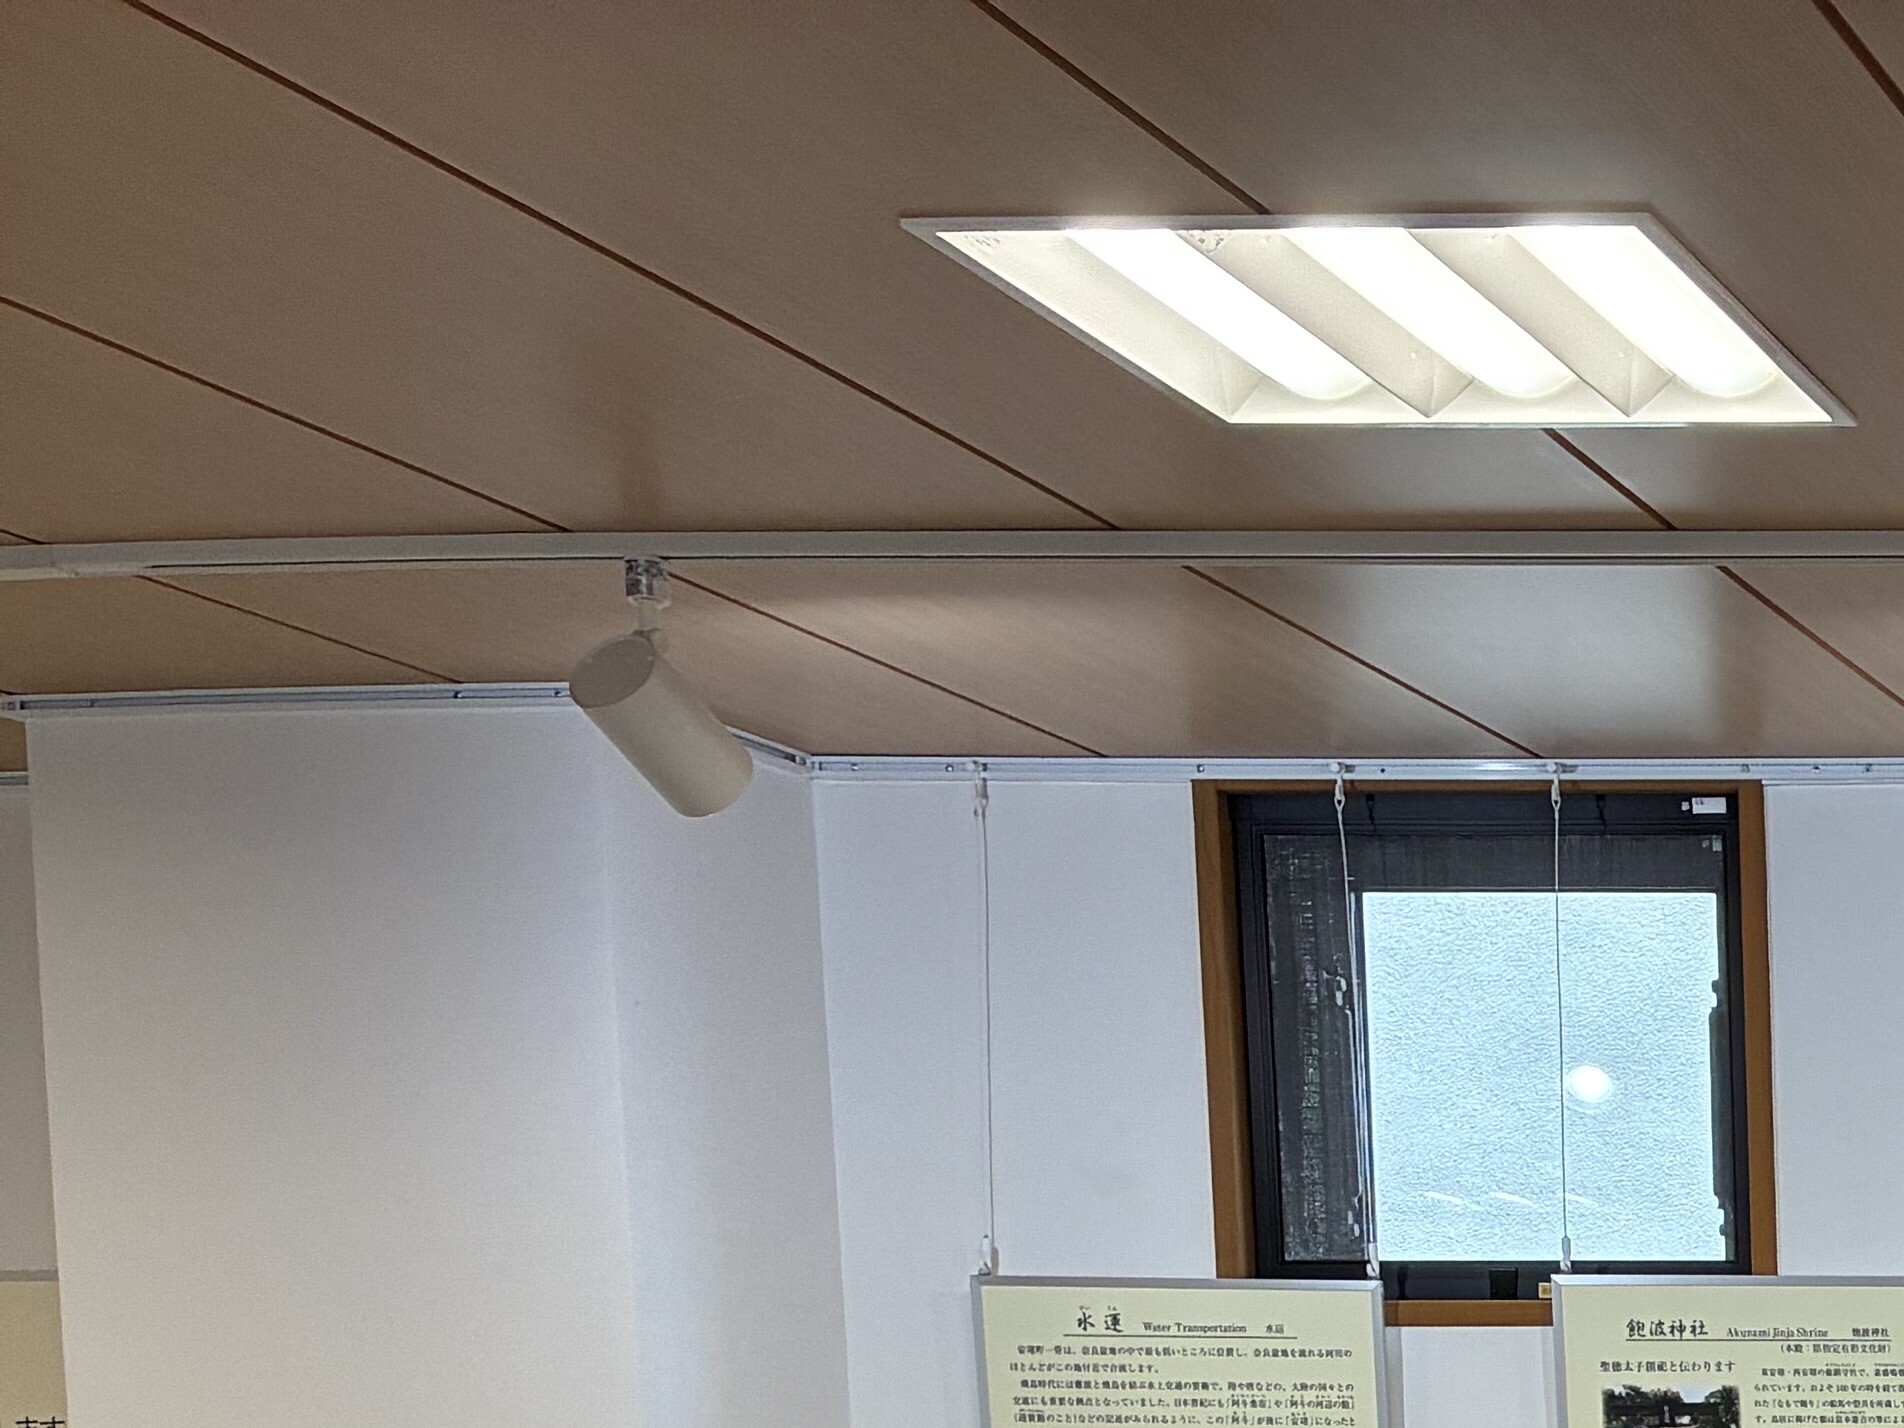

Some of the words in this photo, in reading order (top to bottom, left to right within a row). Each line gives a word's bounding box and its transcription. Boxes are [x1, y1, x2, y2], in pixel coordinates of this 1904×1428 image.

[1077, 1312, 1123, 1332] 水運
[1143, 1322, 1171, 1334] Water
[1175, 1323, 1247, 1335] Transportation
[1627, 1319, 1708, 1339] 飽波神社
[1772, 1327, 1795, 1339] Jinja
[1796, 1327, 1828, 1337] Shrine
